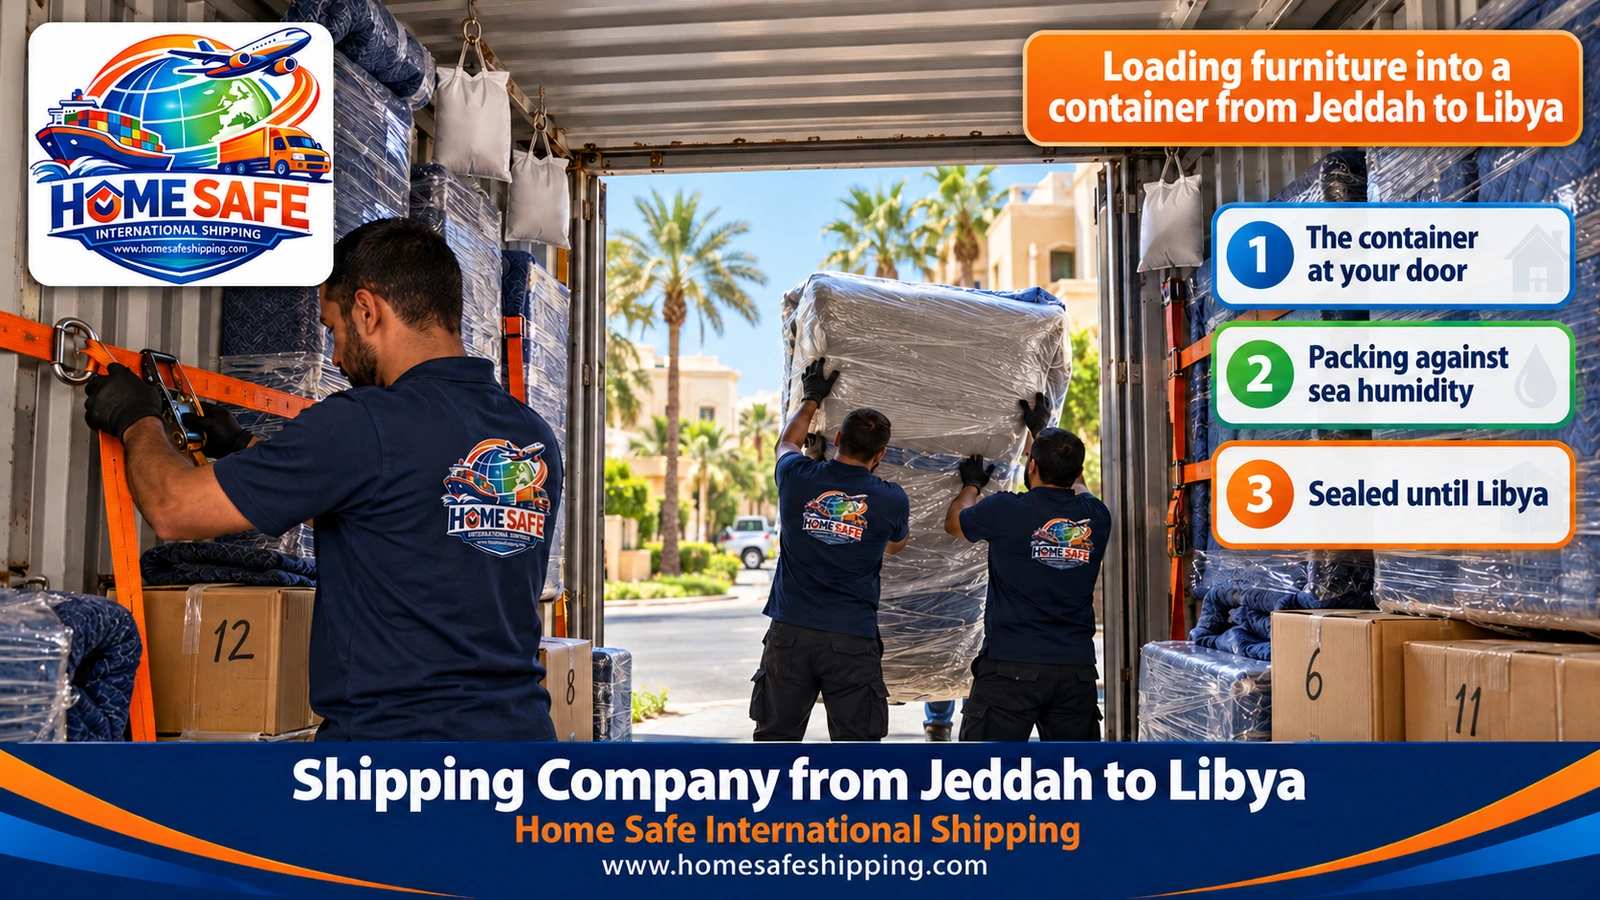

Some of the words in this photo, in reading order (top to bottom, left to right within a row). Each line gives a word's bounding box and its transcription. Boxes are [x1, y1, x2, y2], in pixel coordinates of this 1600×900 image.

[449, 507, 505, 531] HOME
[506, 509, 544, 537] SAFE
[804, 518, 835, 530] HOME
[835, 523, 862, 539] SAFE
[1064, 548, 1089, 561] SAFE
[213, 619, 255, 663] 12
[566, 668, 575, 705] 8
[1305, 648, 1323, 701] 6
[1455, 683, 1481, 737] 11
